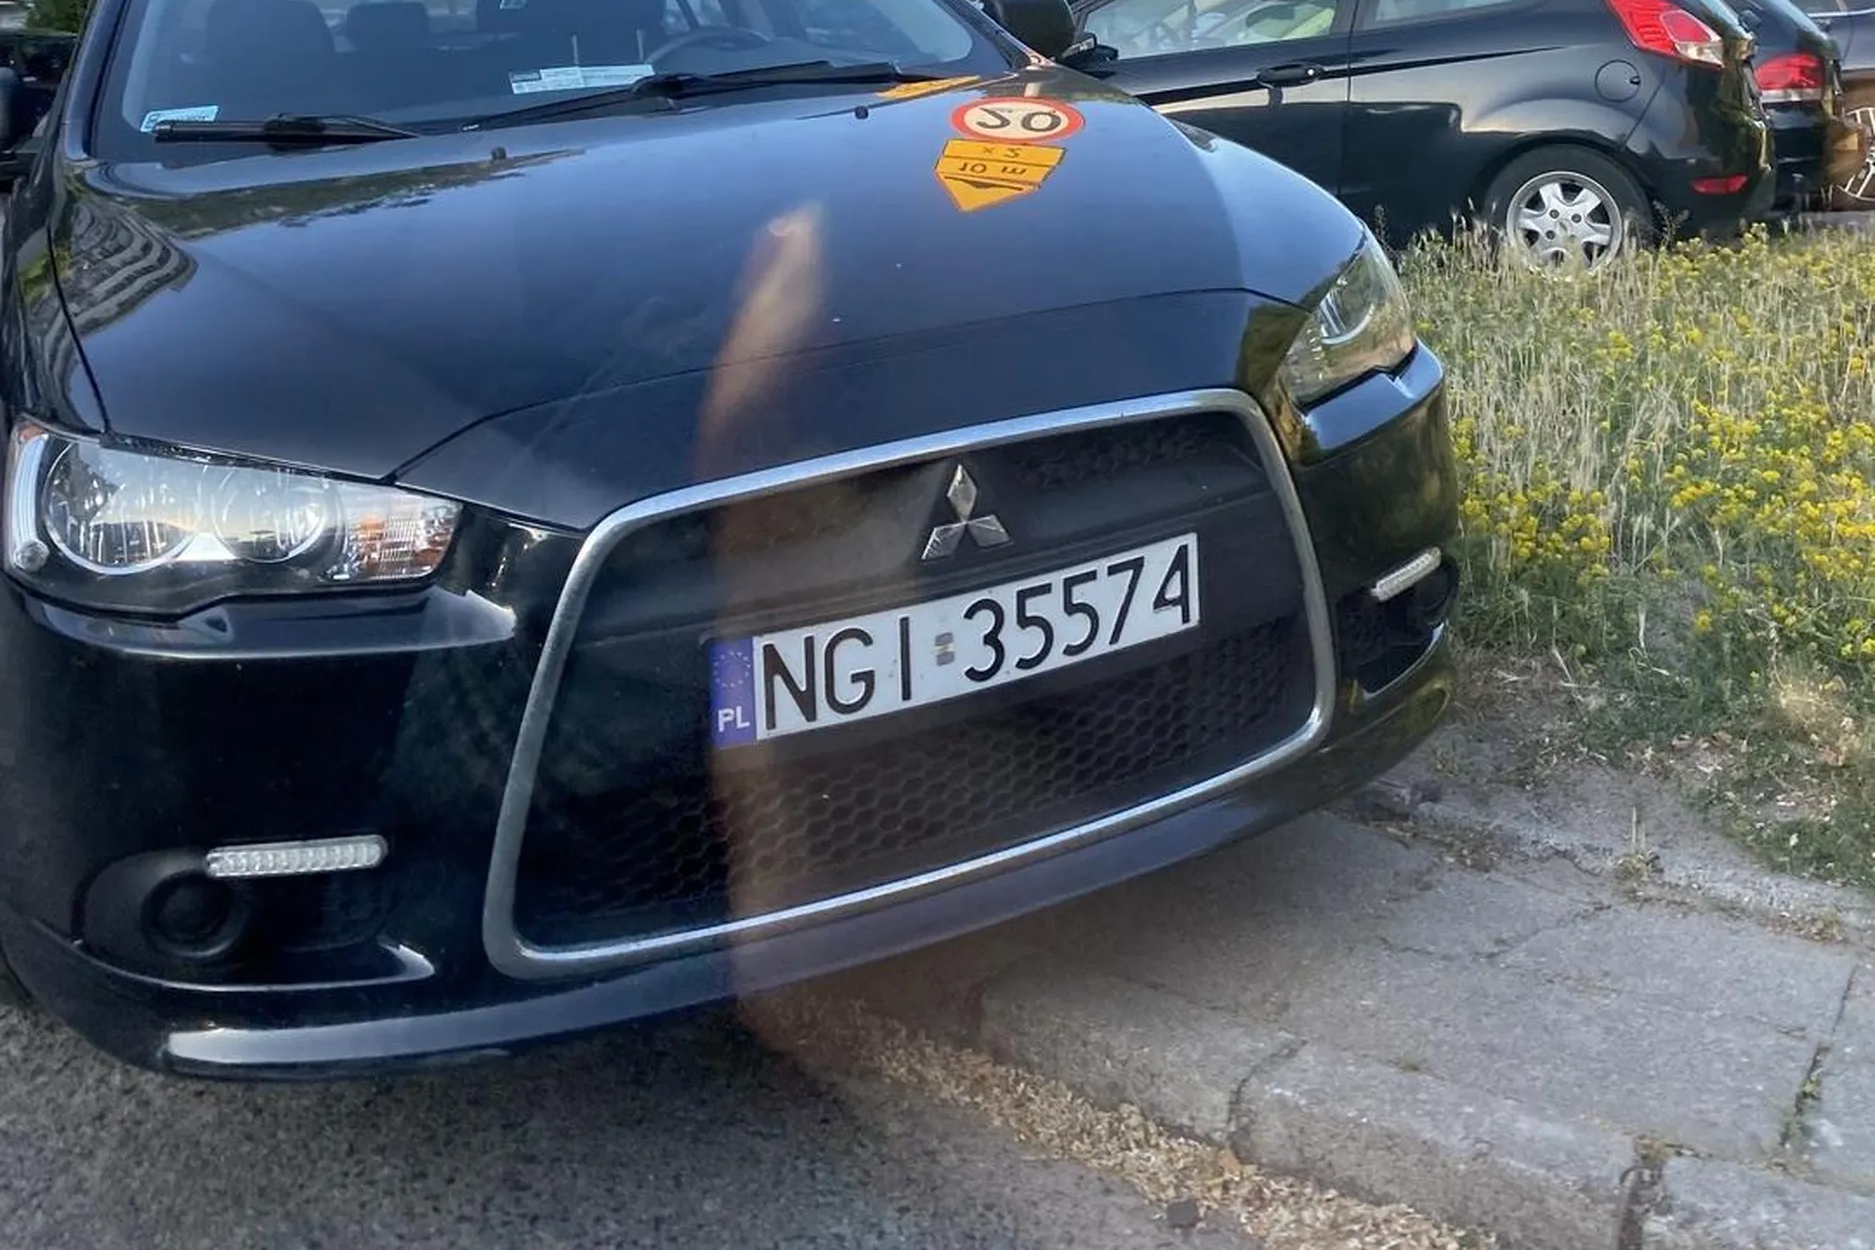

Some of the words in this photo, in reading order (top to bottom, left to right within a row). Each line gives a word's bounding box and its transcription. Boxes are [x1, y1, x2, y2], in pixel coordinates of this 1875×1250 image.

[763, 617, 911, 730] NGI
[963, 544, 1191, 682] 35574
[718, 706, 751, 732] PL
